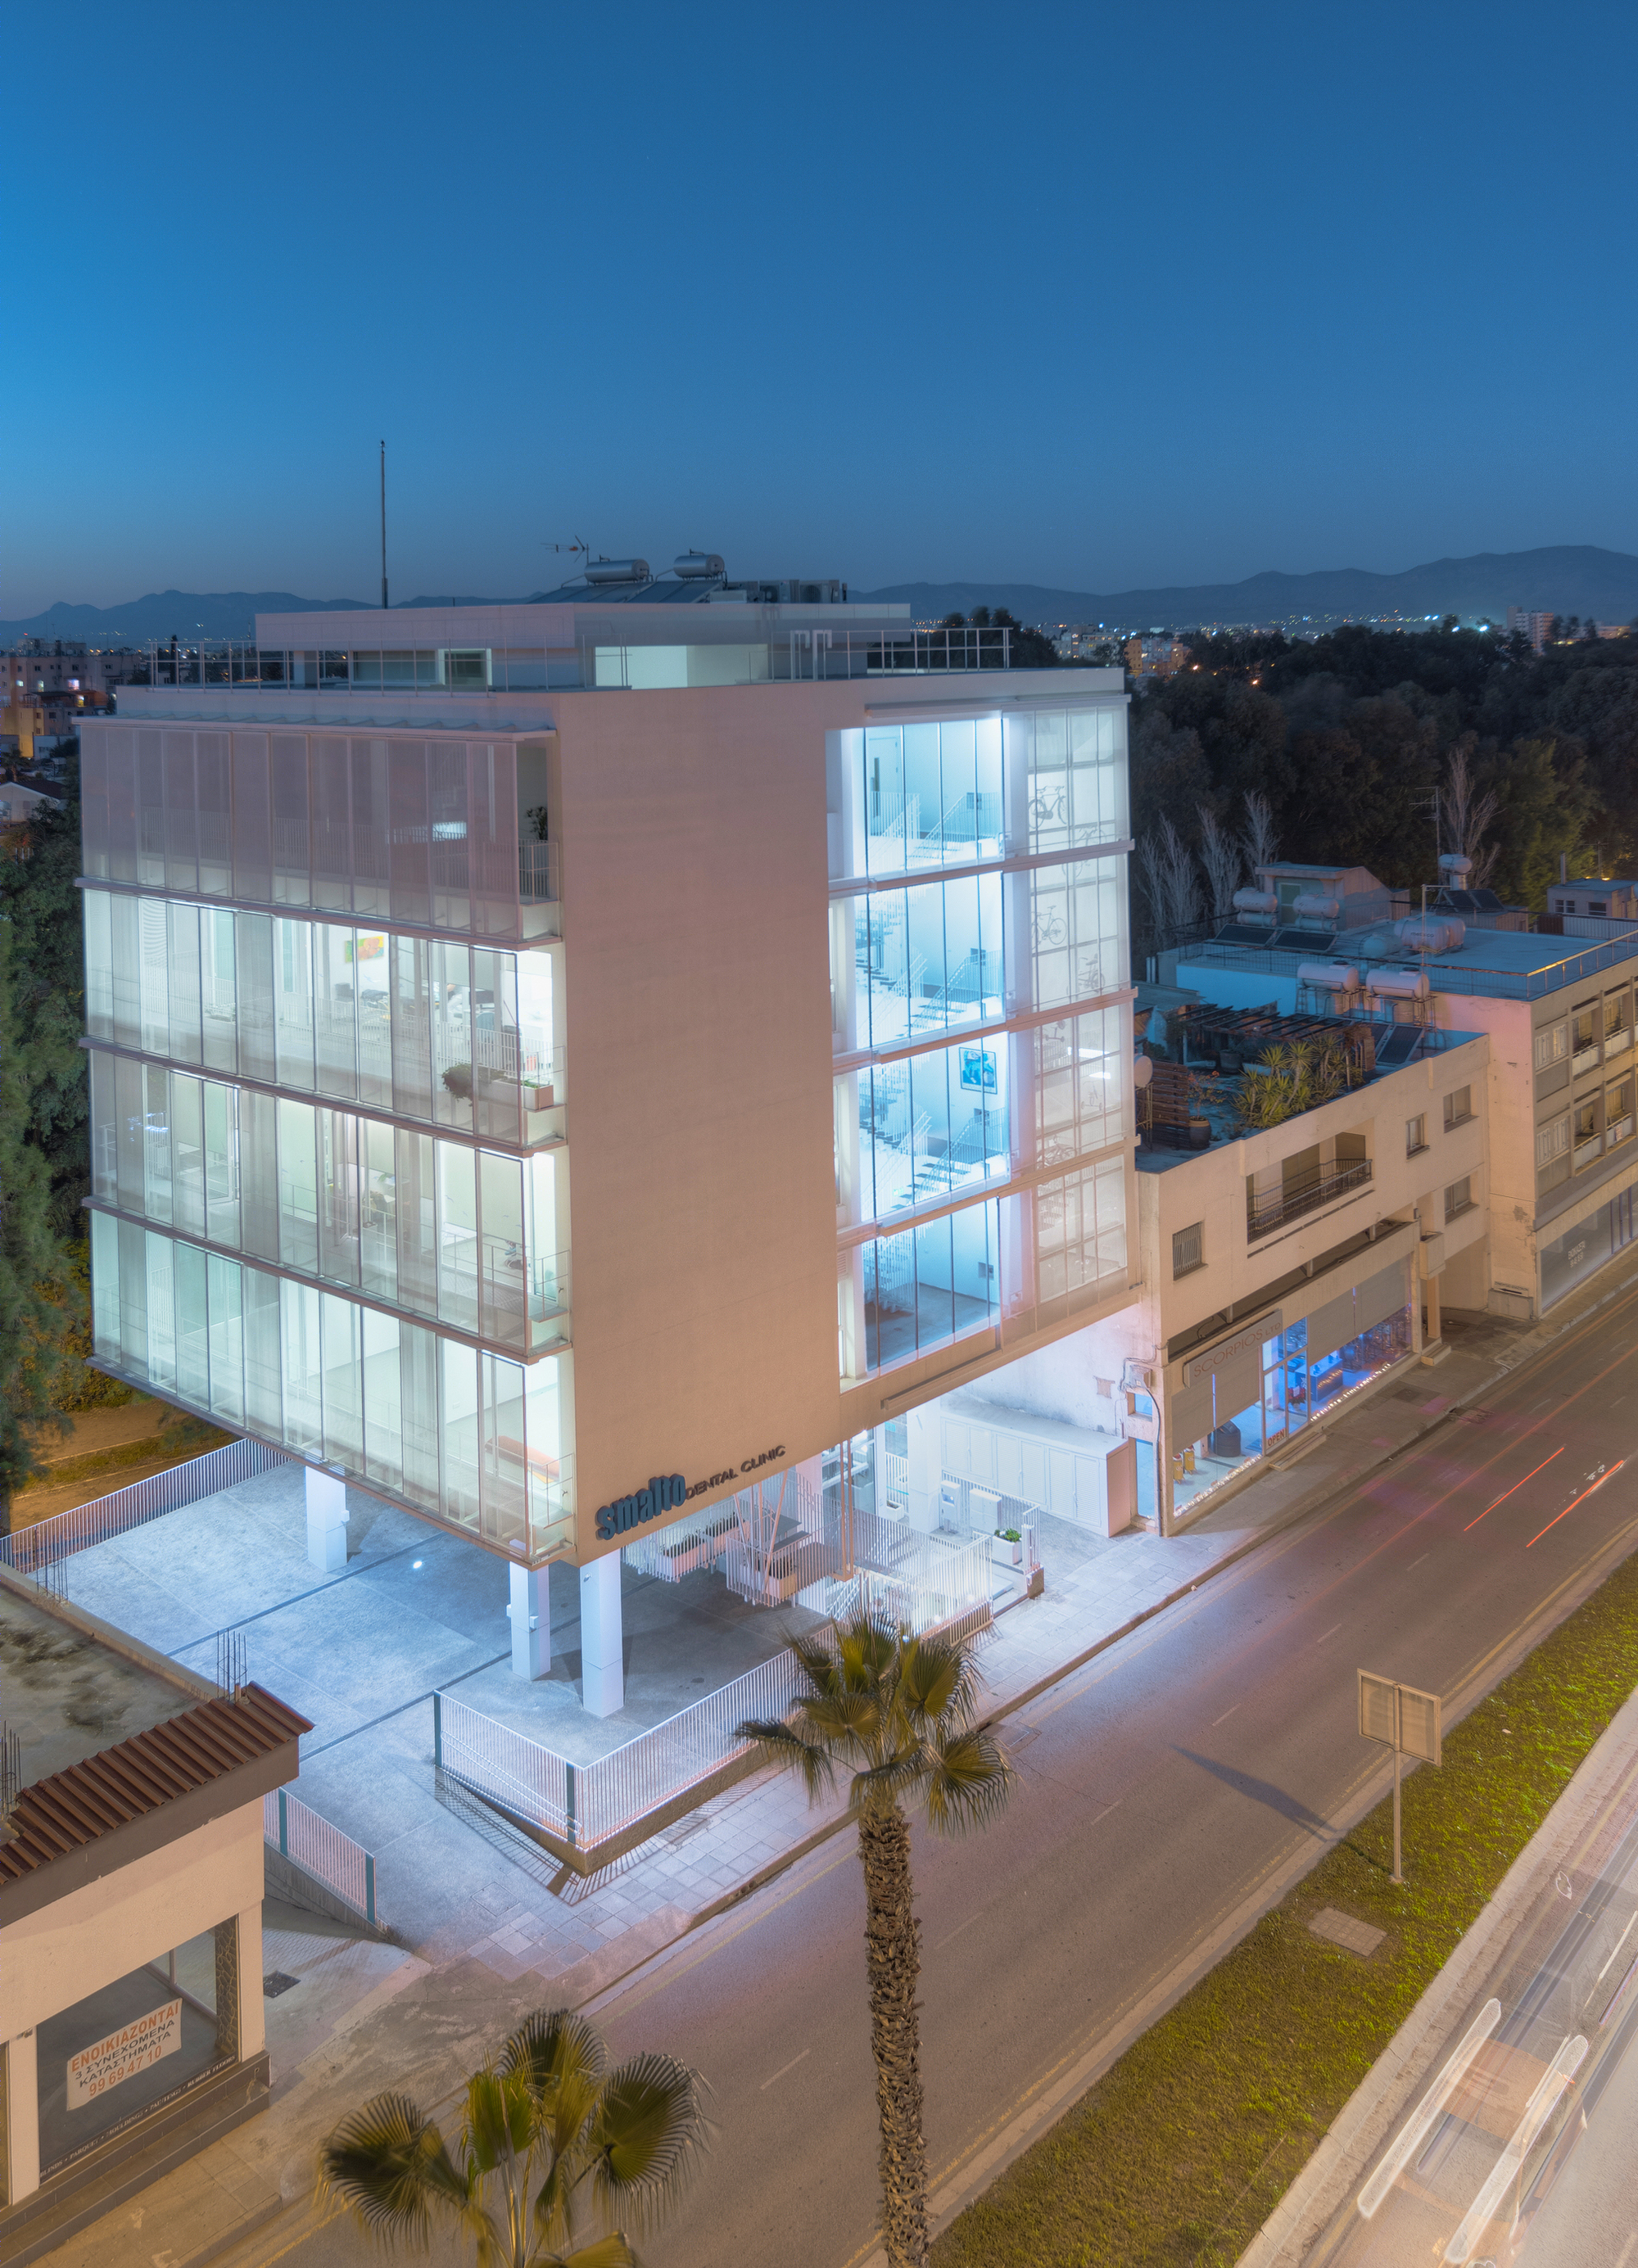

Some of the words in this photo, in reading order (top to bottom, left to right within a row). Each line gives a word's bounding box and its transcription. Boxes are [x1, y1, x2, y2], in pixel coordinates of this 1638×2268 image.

[1194, 1328, 1263, 1377] SCORPIOS
[1265, 1322, 1282, 1335] LTD
[1268, 1428, 1285, 1447] OPEN
[595, 1473, 686, 1541] smalto
[686, 1468, 739, 1501] DENTAL
[740, 1445, 786, 1473] CLINIC
[71, 2001, 179, 2072] ΕΝΟΙΚΙΑΖΟΝΤΑΙ
[75, 2071, 83, 2080] 3
[86, 2019, 175, 2074] ΣΥΝΕΧΟΜΕΝΑ
[79, 2031, 171, 2088] ΚΑΤΑΣΤΗΜΑΤΑ
[89, 2077, 106, 2097] 99
[109, 2066, 124, 2085] 69
[127, 2055, 144, 2074] 47
[147, 2044, 162, 2062] 10
[40, 2159, 63, 2178] BLINDS
[70, 2139, 99, 2160] PARQUET
[212, 2054, 236, 2073] FLOORS
